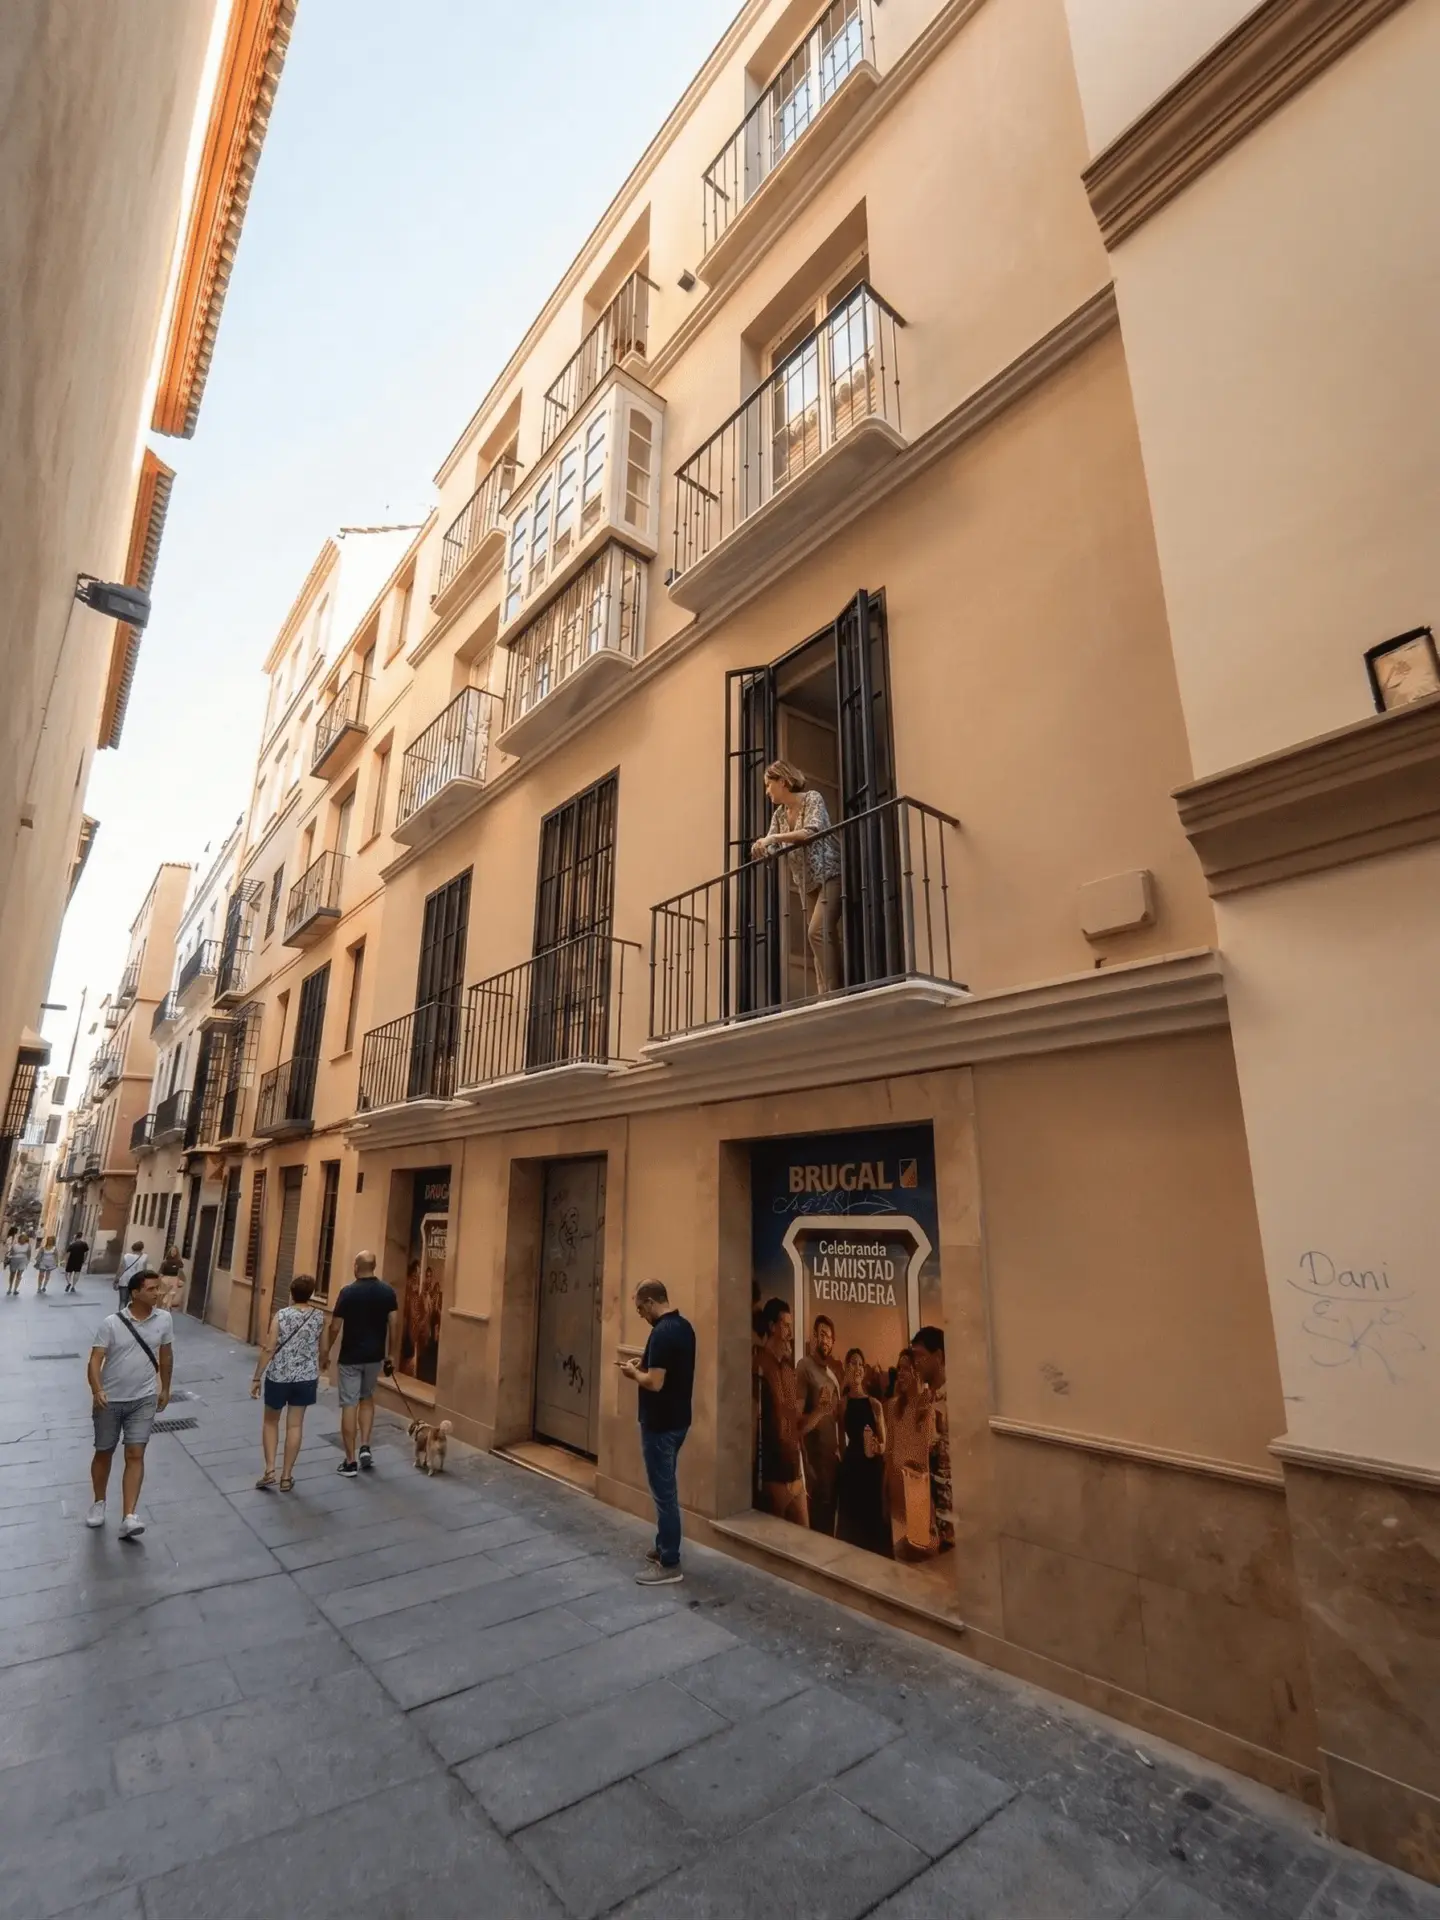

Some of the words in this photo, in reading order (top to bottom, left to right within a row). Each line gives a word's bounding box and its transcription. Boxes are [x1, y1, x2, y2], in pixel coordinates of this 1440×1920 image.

[789, 1161, 894, 1193] BRUGAL
[813, 1256, 831, 1277] LA
[1300, 1251, 1390, 1291] Dani
